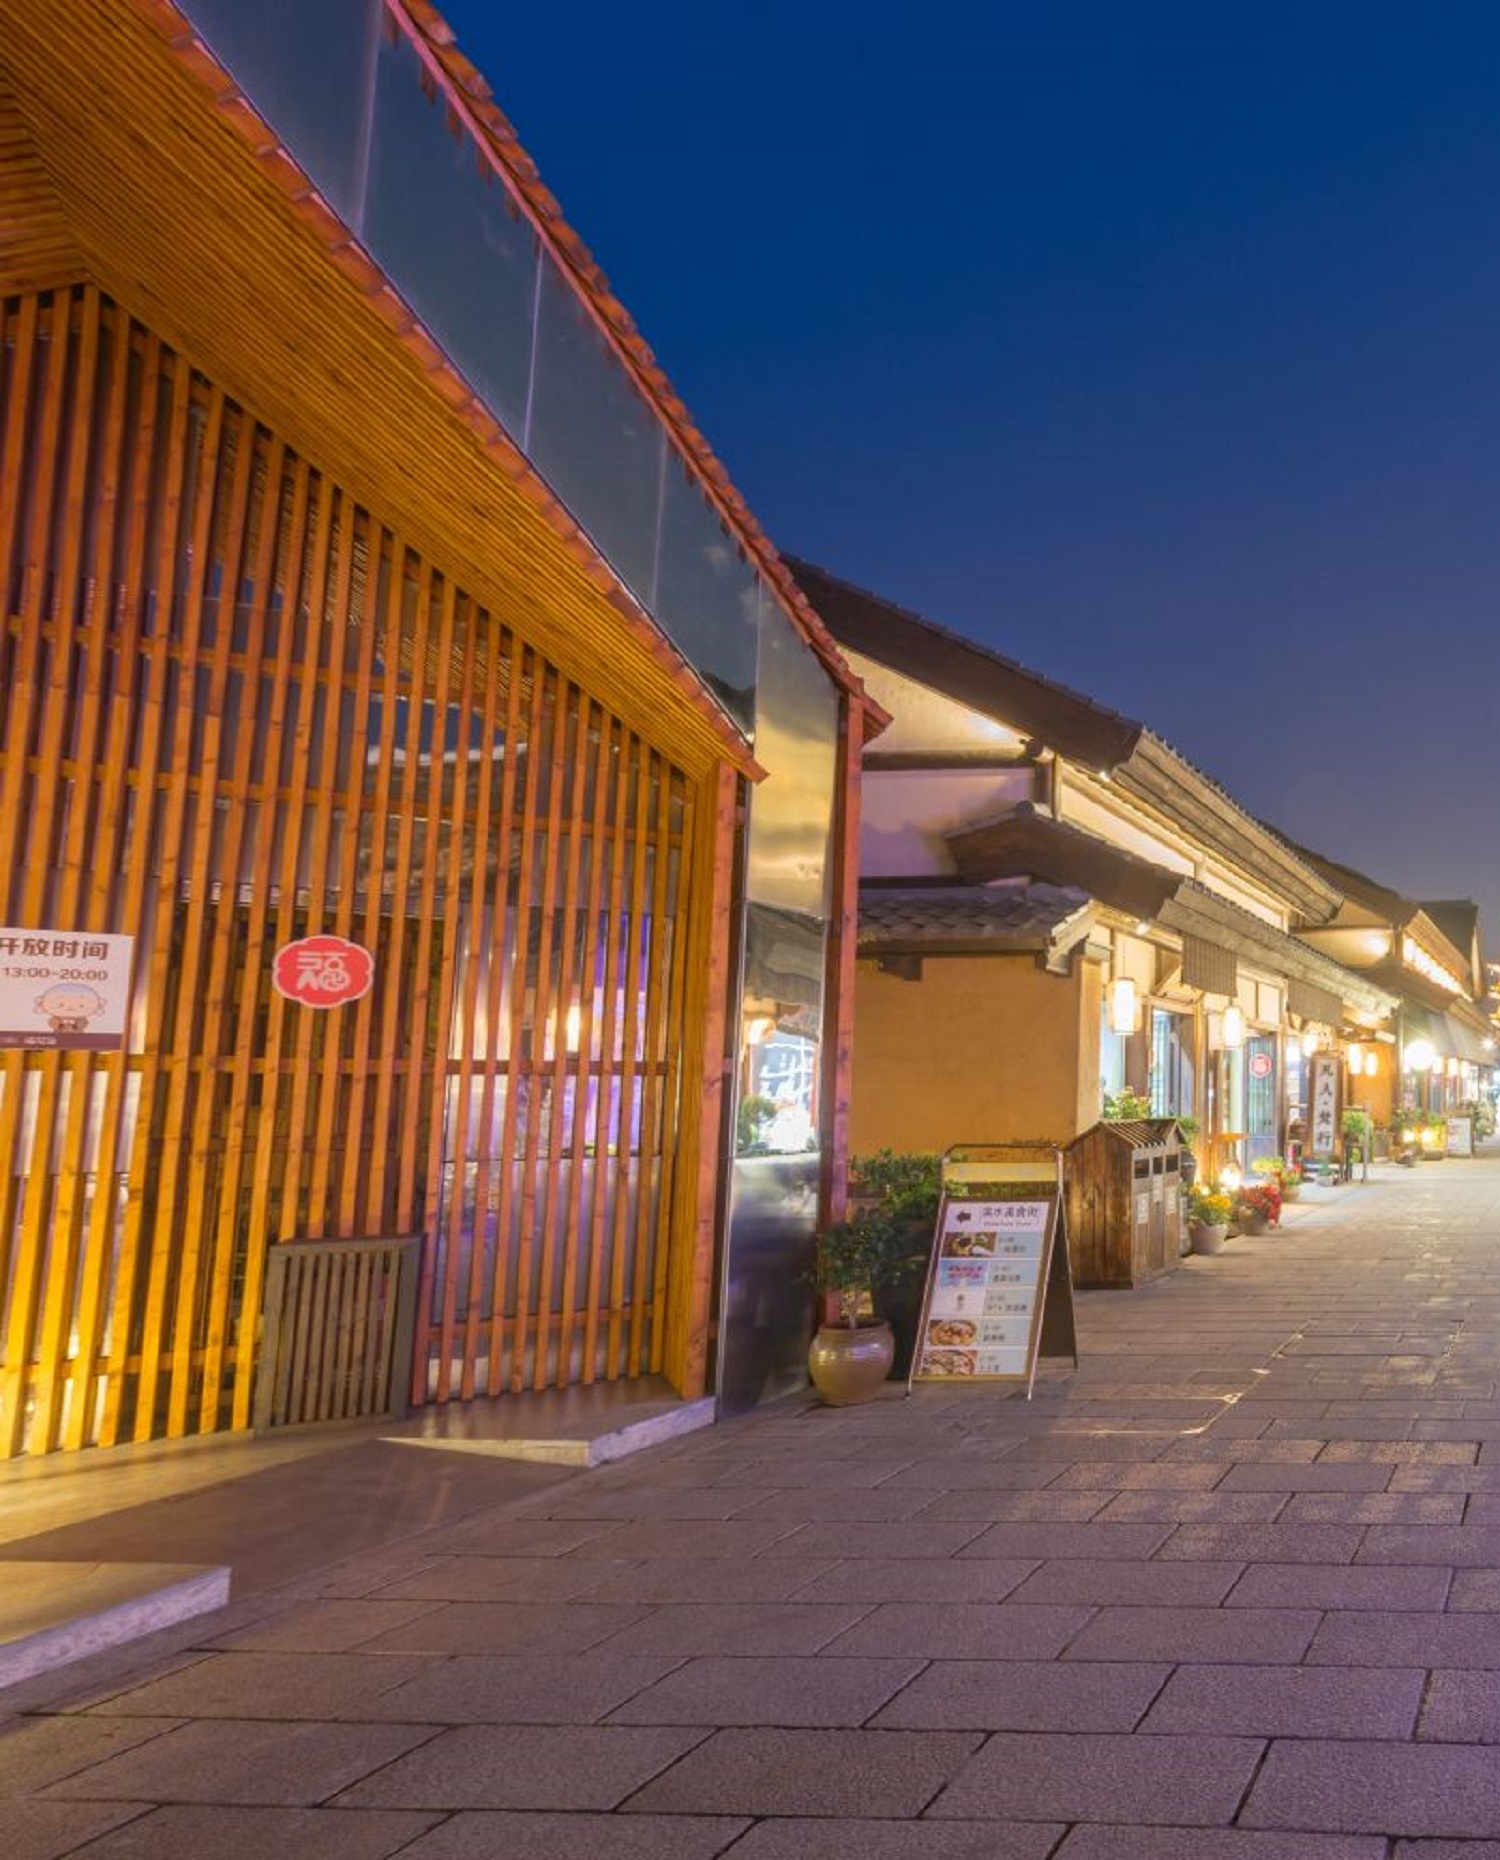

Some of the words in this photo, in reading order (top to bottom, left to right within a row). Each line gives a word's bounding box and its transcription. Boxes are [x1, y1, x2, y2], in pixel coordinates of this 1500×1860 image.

[0, 938, 109, 960] 开放时间
[3, 966, 108, 981] 13:00-20:00
